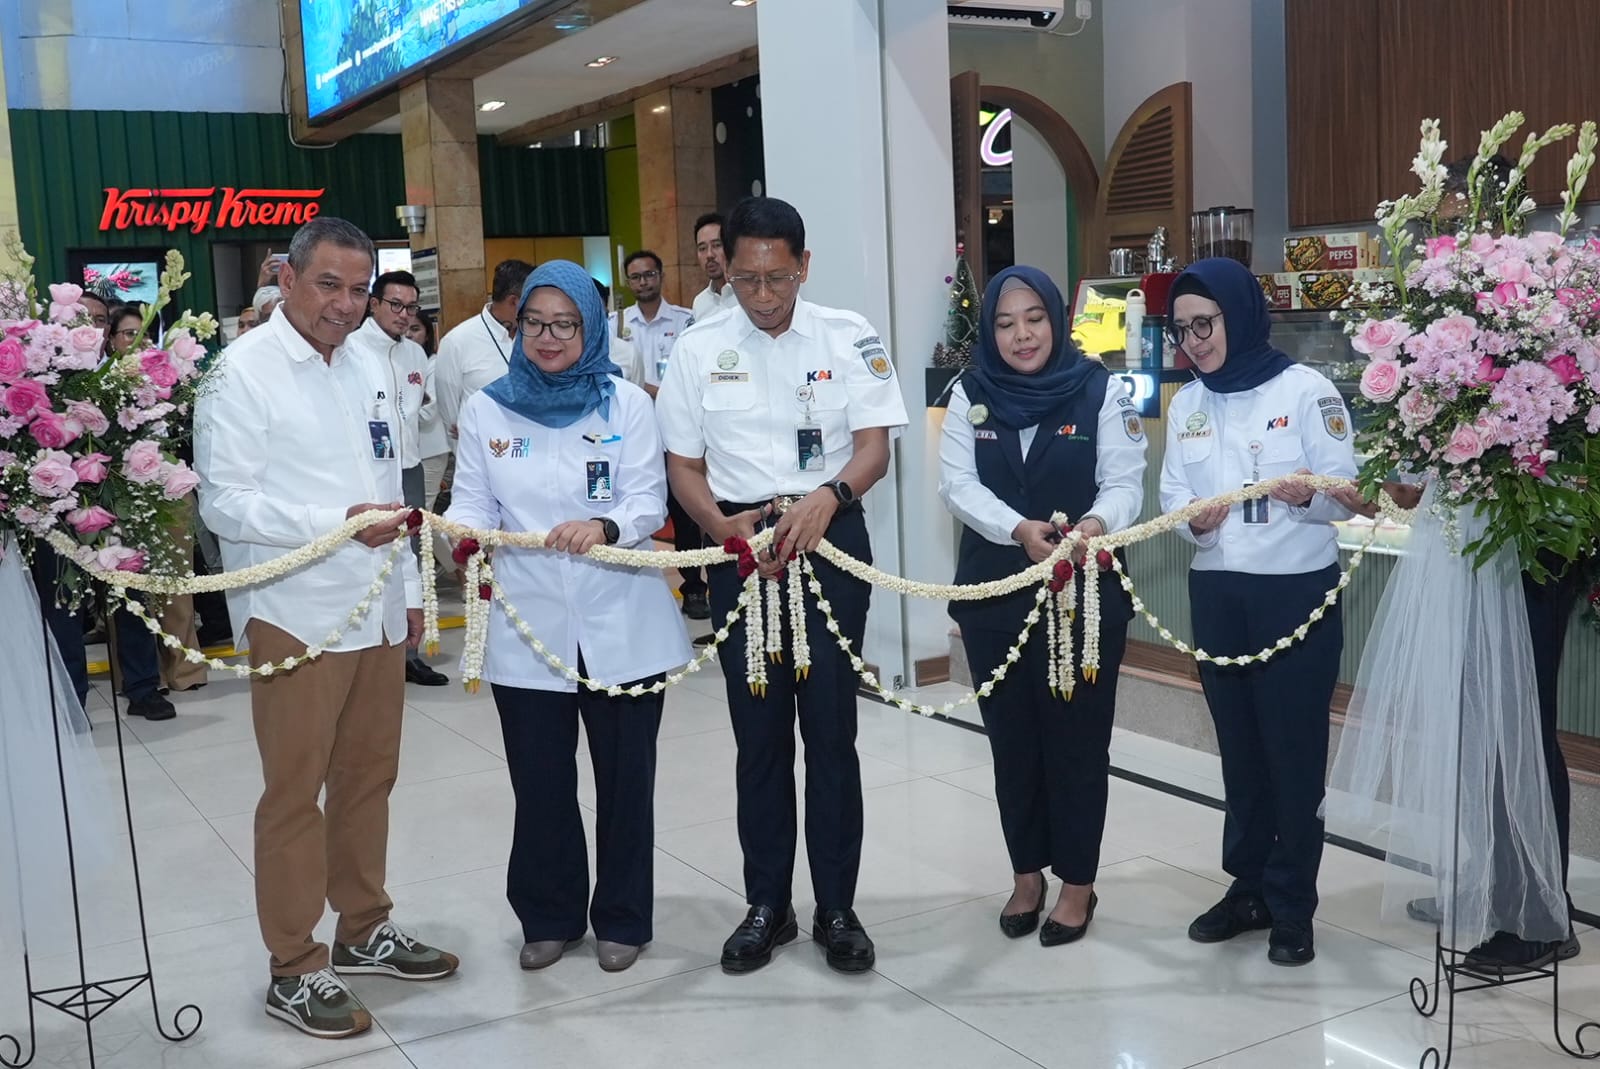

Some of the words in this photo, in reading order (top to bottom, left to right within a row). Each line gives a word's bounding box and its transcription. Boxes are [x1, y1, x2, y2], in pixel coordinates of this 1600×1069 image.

[99, 187, 215, 234] Krispy
[215, 187, 325, 229] Kreme
[1329, 249, 1353, 260] PEPES
